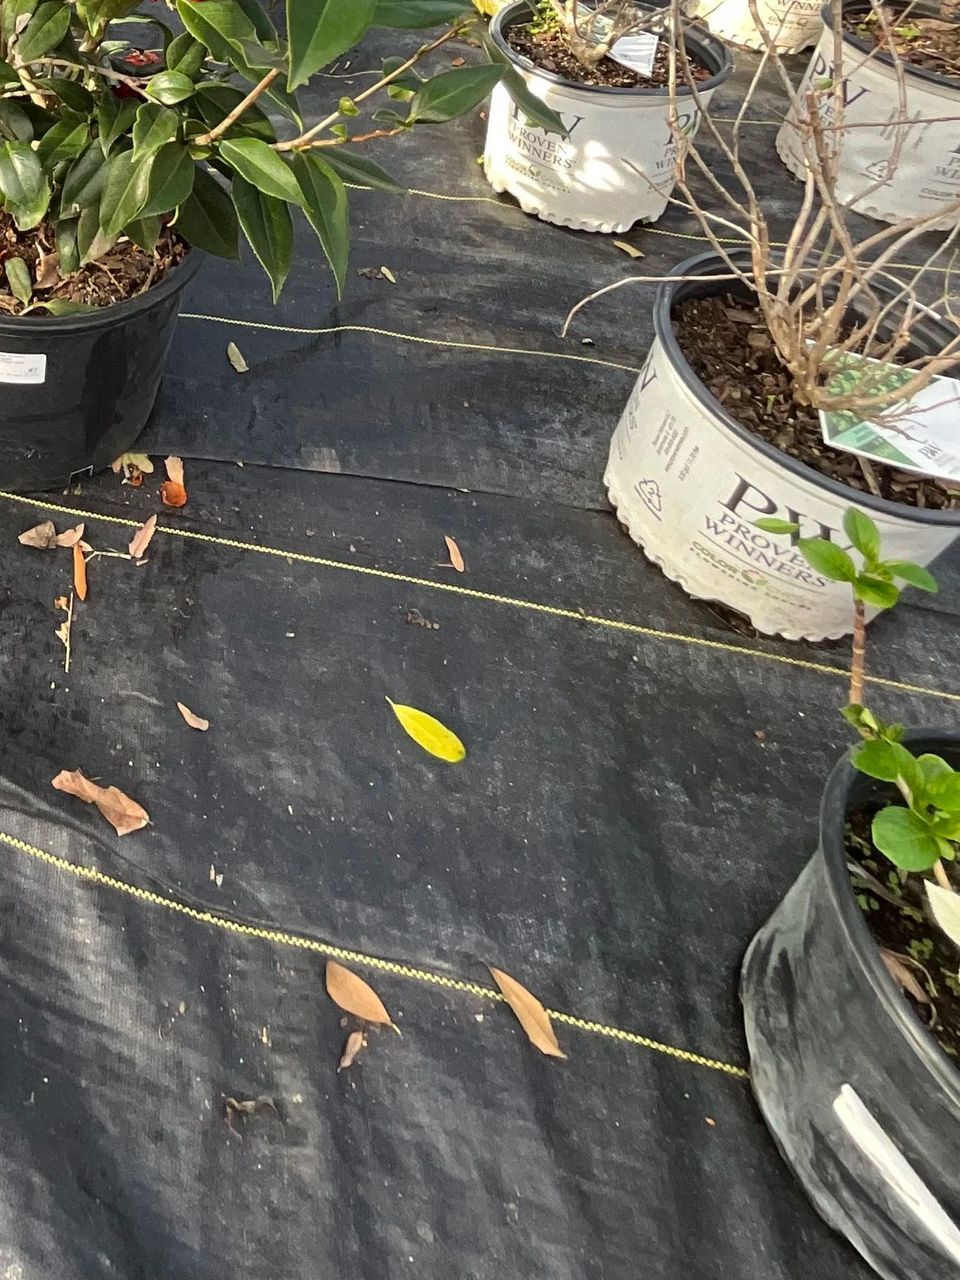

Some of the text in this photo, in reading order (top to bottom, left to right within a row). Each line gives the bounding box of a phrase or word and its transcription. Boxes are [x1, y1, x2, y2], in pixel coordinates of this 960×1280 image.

[507, 128, 572, 169] WINNERS
[705, 515, 827, 588] WINNERS
[719, 512, 813, 571] PROVE
